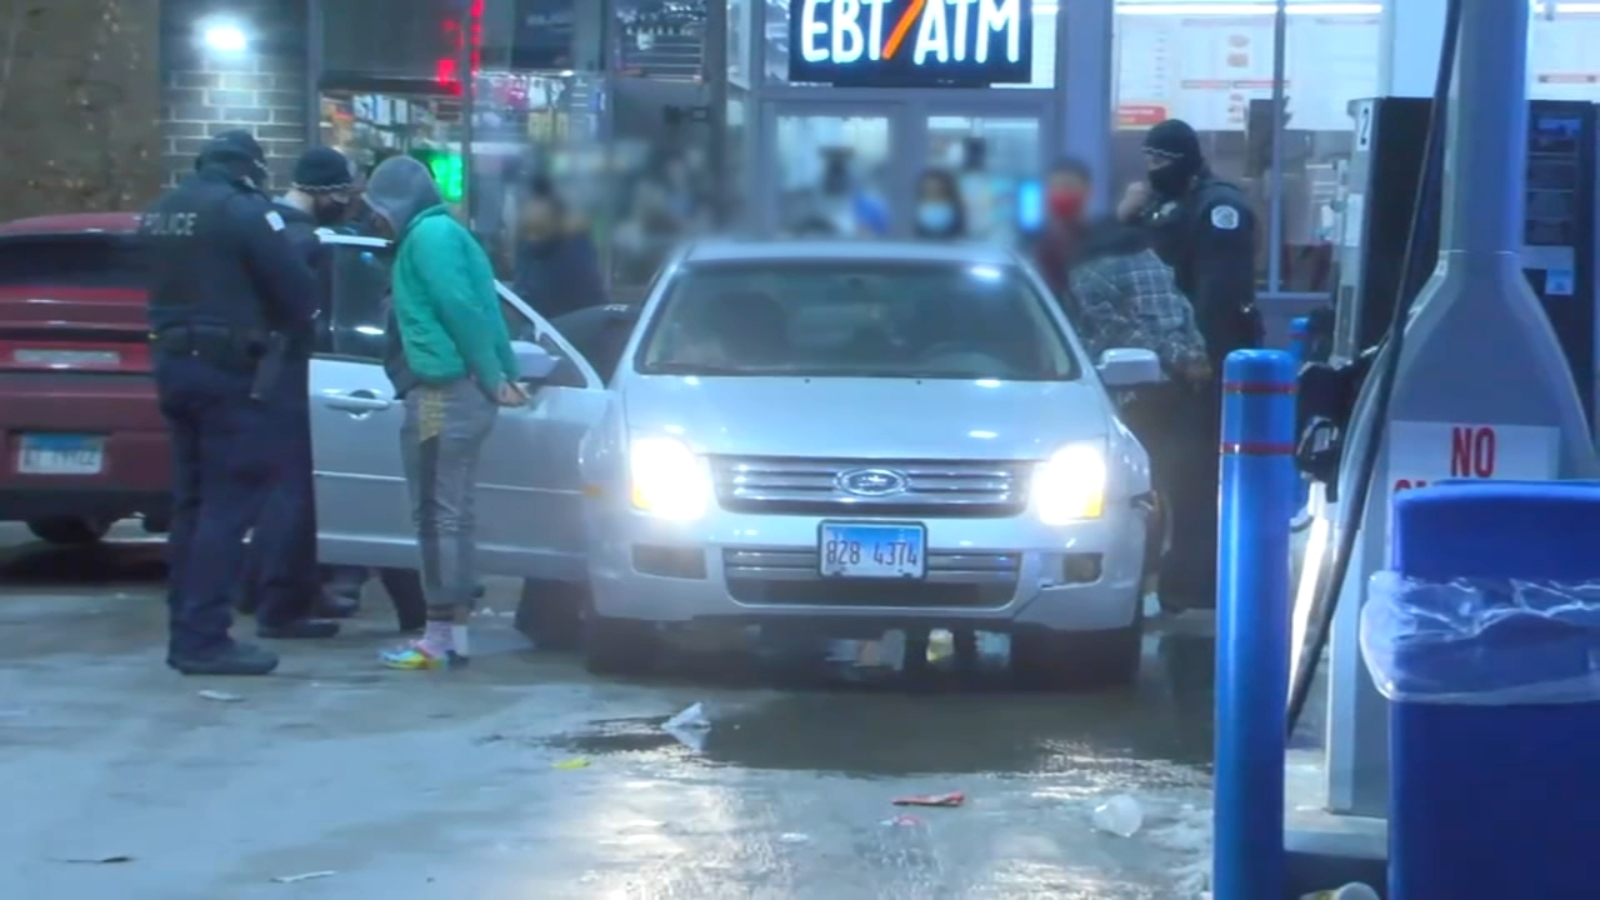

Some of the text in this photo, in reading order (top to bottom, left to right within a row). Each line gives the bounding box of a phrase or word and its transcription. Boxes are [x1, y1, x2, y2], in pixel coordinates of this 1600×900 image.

[143, 211, 198, 237] POLICE
[1450, 426, 1497, 478] NO
[873, 540, 918, 567] 4374
